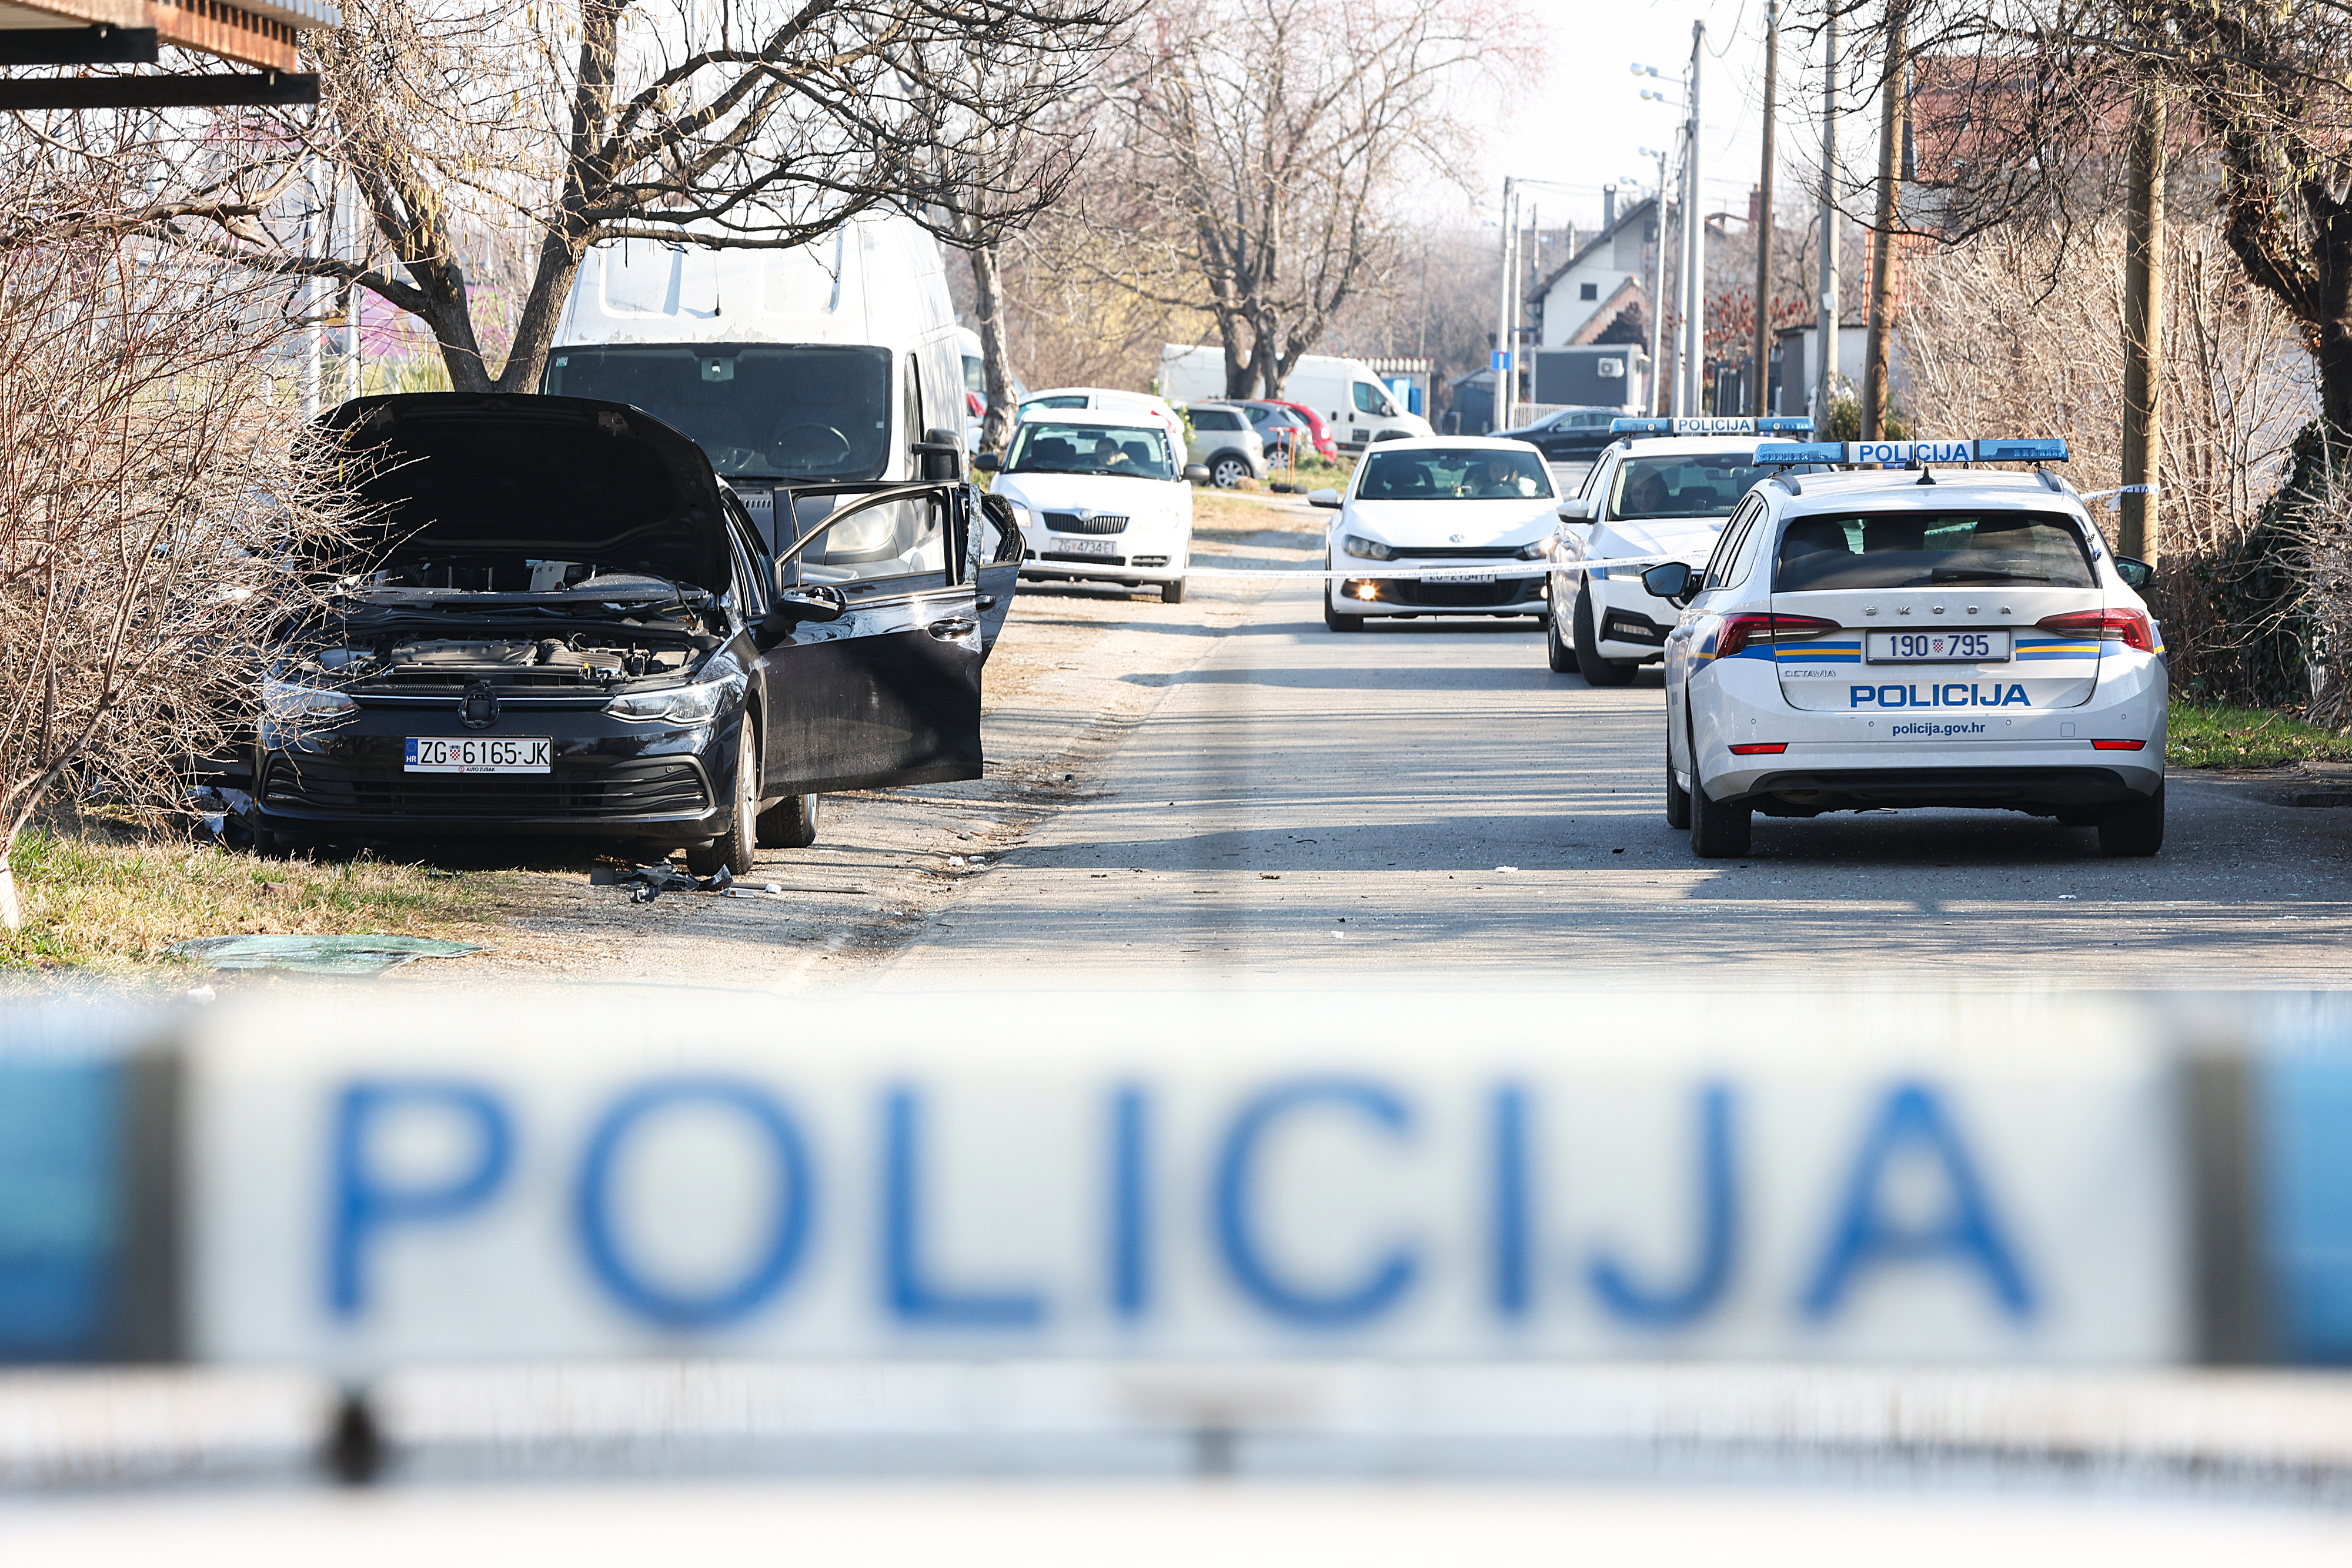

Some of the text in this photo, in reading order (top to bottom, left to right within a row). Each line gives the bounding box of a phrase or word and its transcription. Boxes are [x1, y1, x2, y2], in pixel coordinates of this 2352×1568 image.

[1679, 419, 1750, 431] POLICIJA
[1859, 444, 1969, 462] POLICIJA
[1890, 634, 1989, 657] 190 795
[1850, 684, 2032, 708] POLICIJA
[1892, 723, 1986, 737] policija.gov.hr
[420, 741, 446, 764] ZG
[318, 1079, 2040, 1333] POLICIJA
